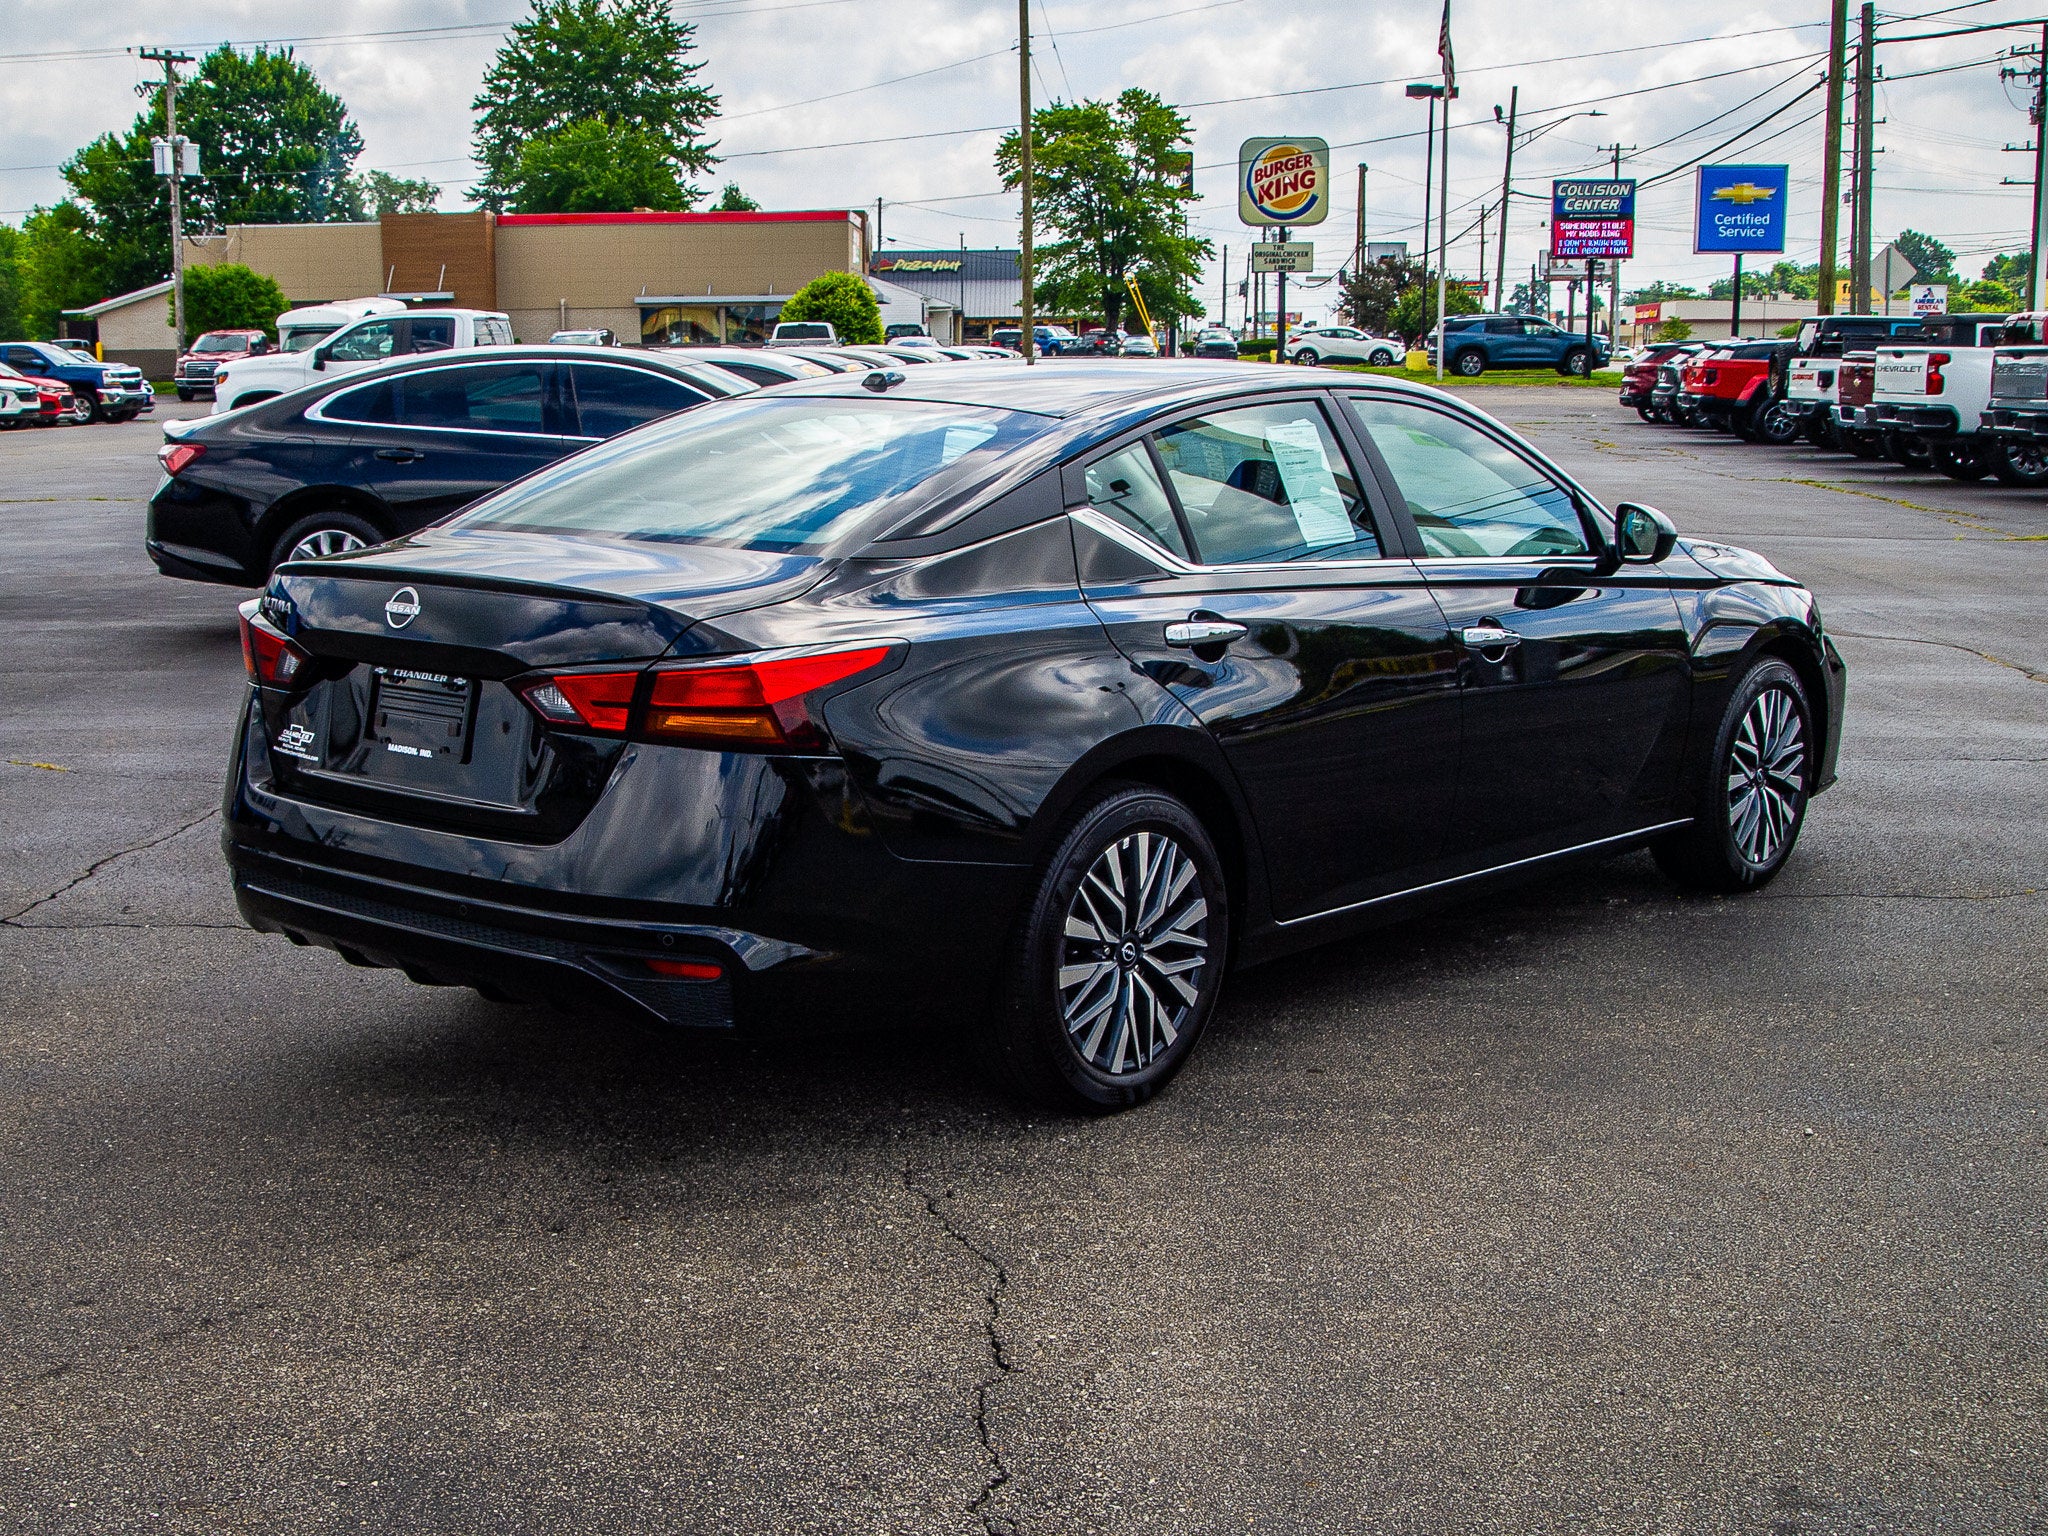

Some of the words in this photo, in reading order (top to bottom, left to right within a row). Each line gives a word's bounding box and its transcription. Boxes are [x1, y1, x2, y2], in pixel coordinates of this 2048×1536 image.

[1254, 154, 1313, 185] BURGER
[1258, 169, 1316, 205] KING
[1557, 183, 1631, 196] COLLISION
[1564, 198, 1620, 211] CENTER
[1560, 221, 1600, 230] SOMEBODY
[1601, 221, 1626, 230] STOLE
[1714, 213, 1770, 225] Certified
[1565, 229, 1577, 238] MY
[1718, 226, 1765, 237] Service
[1581, 247, 1606, 255] ABOUT
[1876, 365, 1923, 373] CHEVROLET
[263, 595, 292, 615] ALTIMA
[384, 602, 421, 615] NISSAN
[394, 668, 448, 682] CHANDLER
